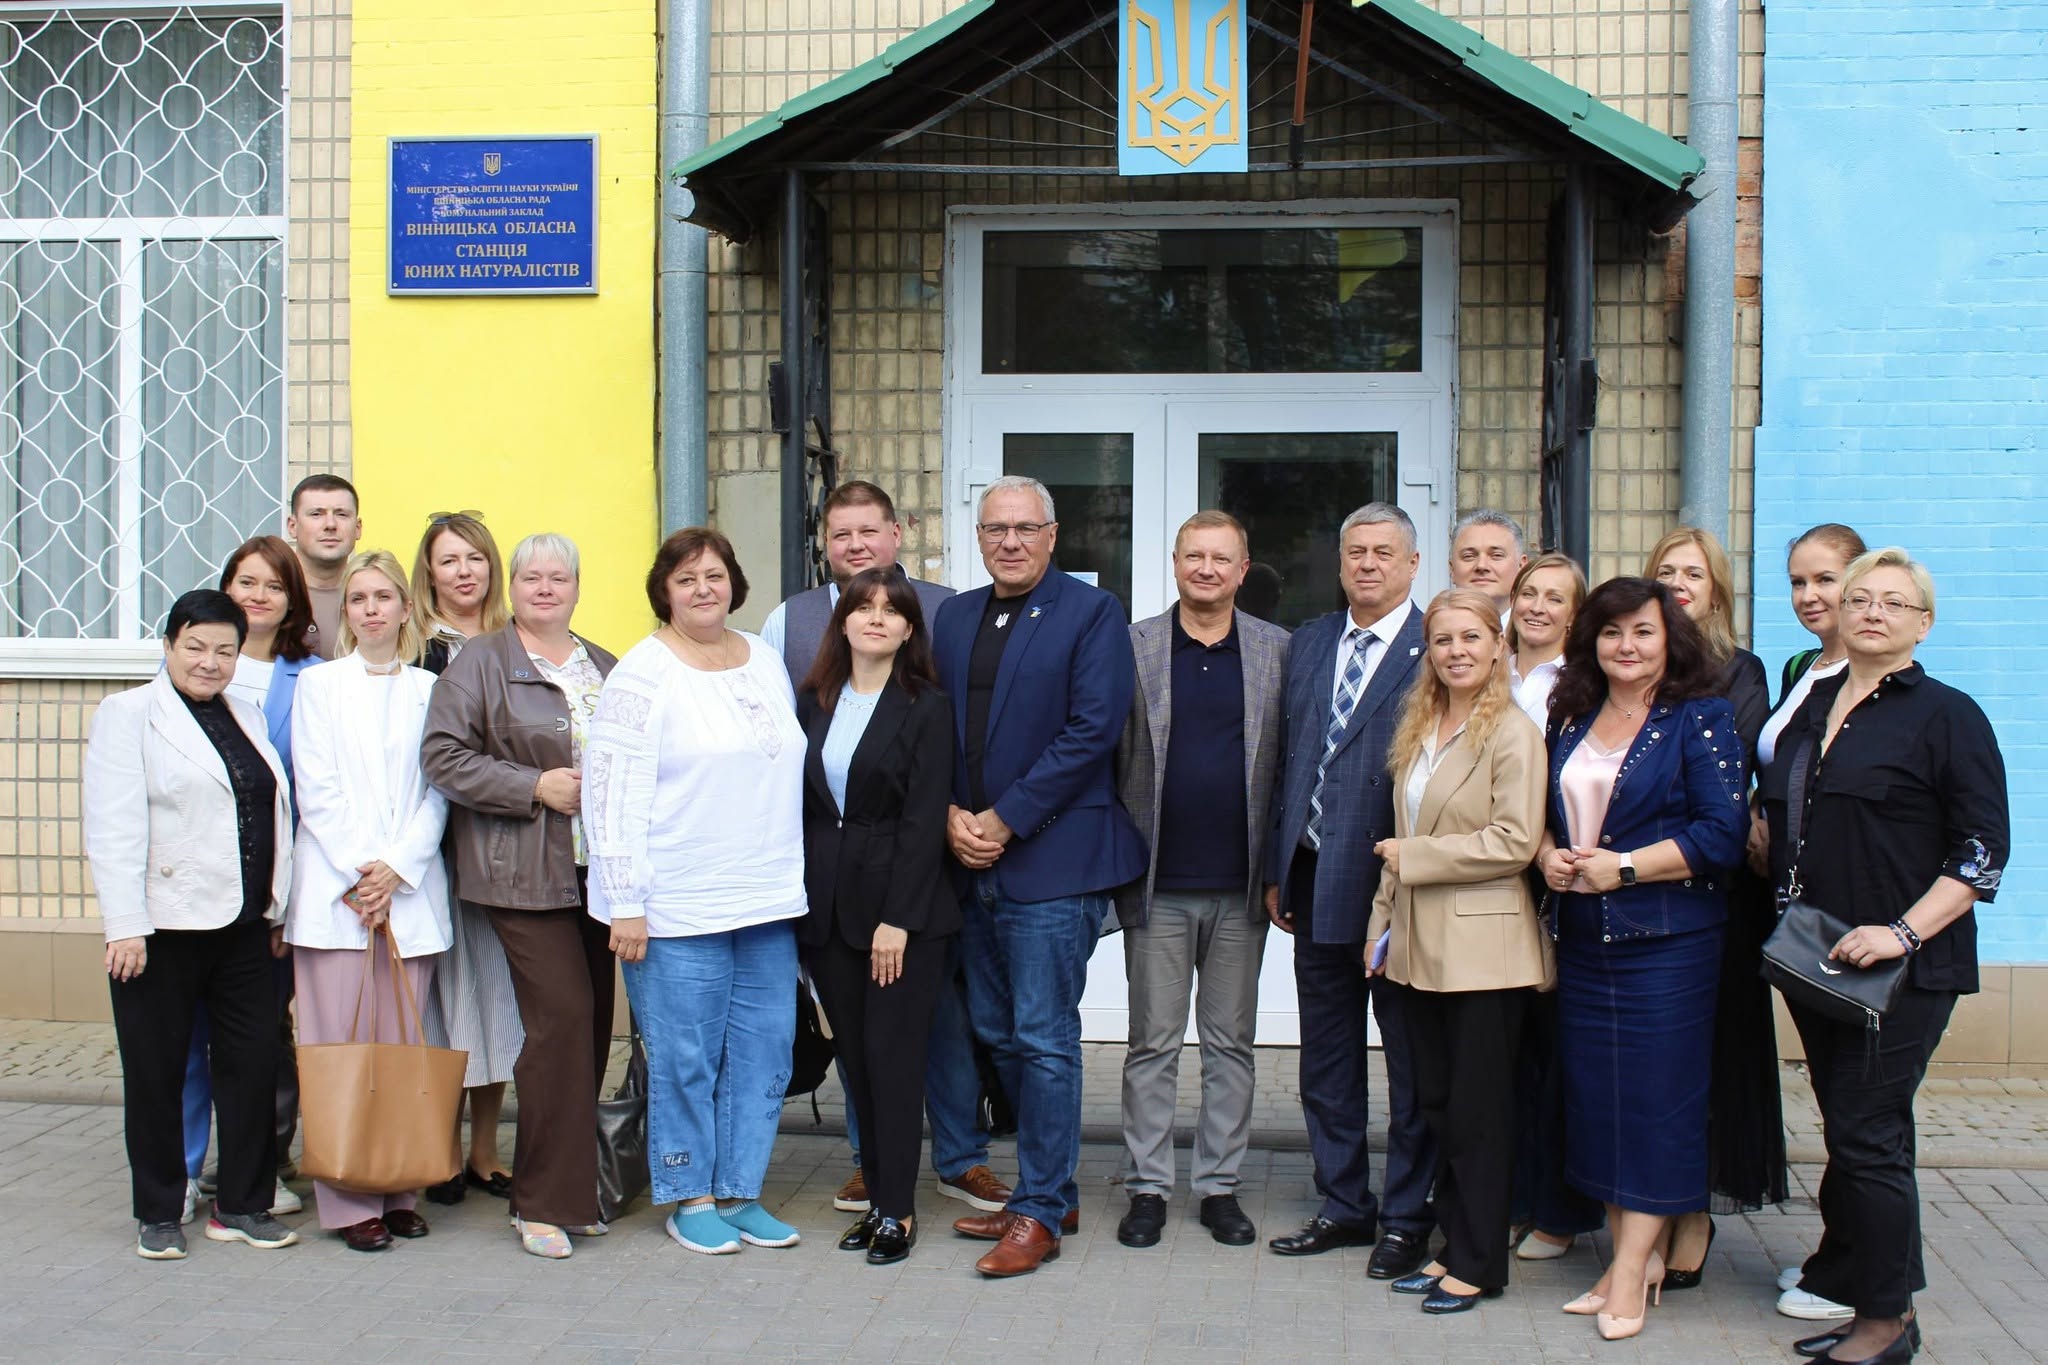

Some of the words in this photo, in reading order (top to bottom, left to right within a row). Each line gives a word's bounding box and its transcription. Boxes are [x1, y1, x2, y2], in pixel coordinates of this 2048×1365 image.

[406, 185, 469, 194] МІНІСТЕРСТВО
[471, 185, 503, 193] ОСВІТИ
[509, 184, 539, 193] НАУКИ
[541, 183, 579, 192] УКРАЇНИ
[486, 196, 527, 204] ОБЛАСНА
[528, 195, 551, 204] РАДА
[509, 207, 545, 217] ЗАКЛАД
[406, 223, 498, 237] ВІННИЦЬКА
[504, 221, 577, 235] ОБЛАСНА
[455, 243, 528, 260] СТАНЦІЯ
[404, 264, 456, 279] ЮНИХ
[459, 263, 580, 278] НАТУРАЛІСТІВ
